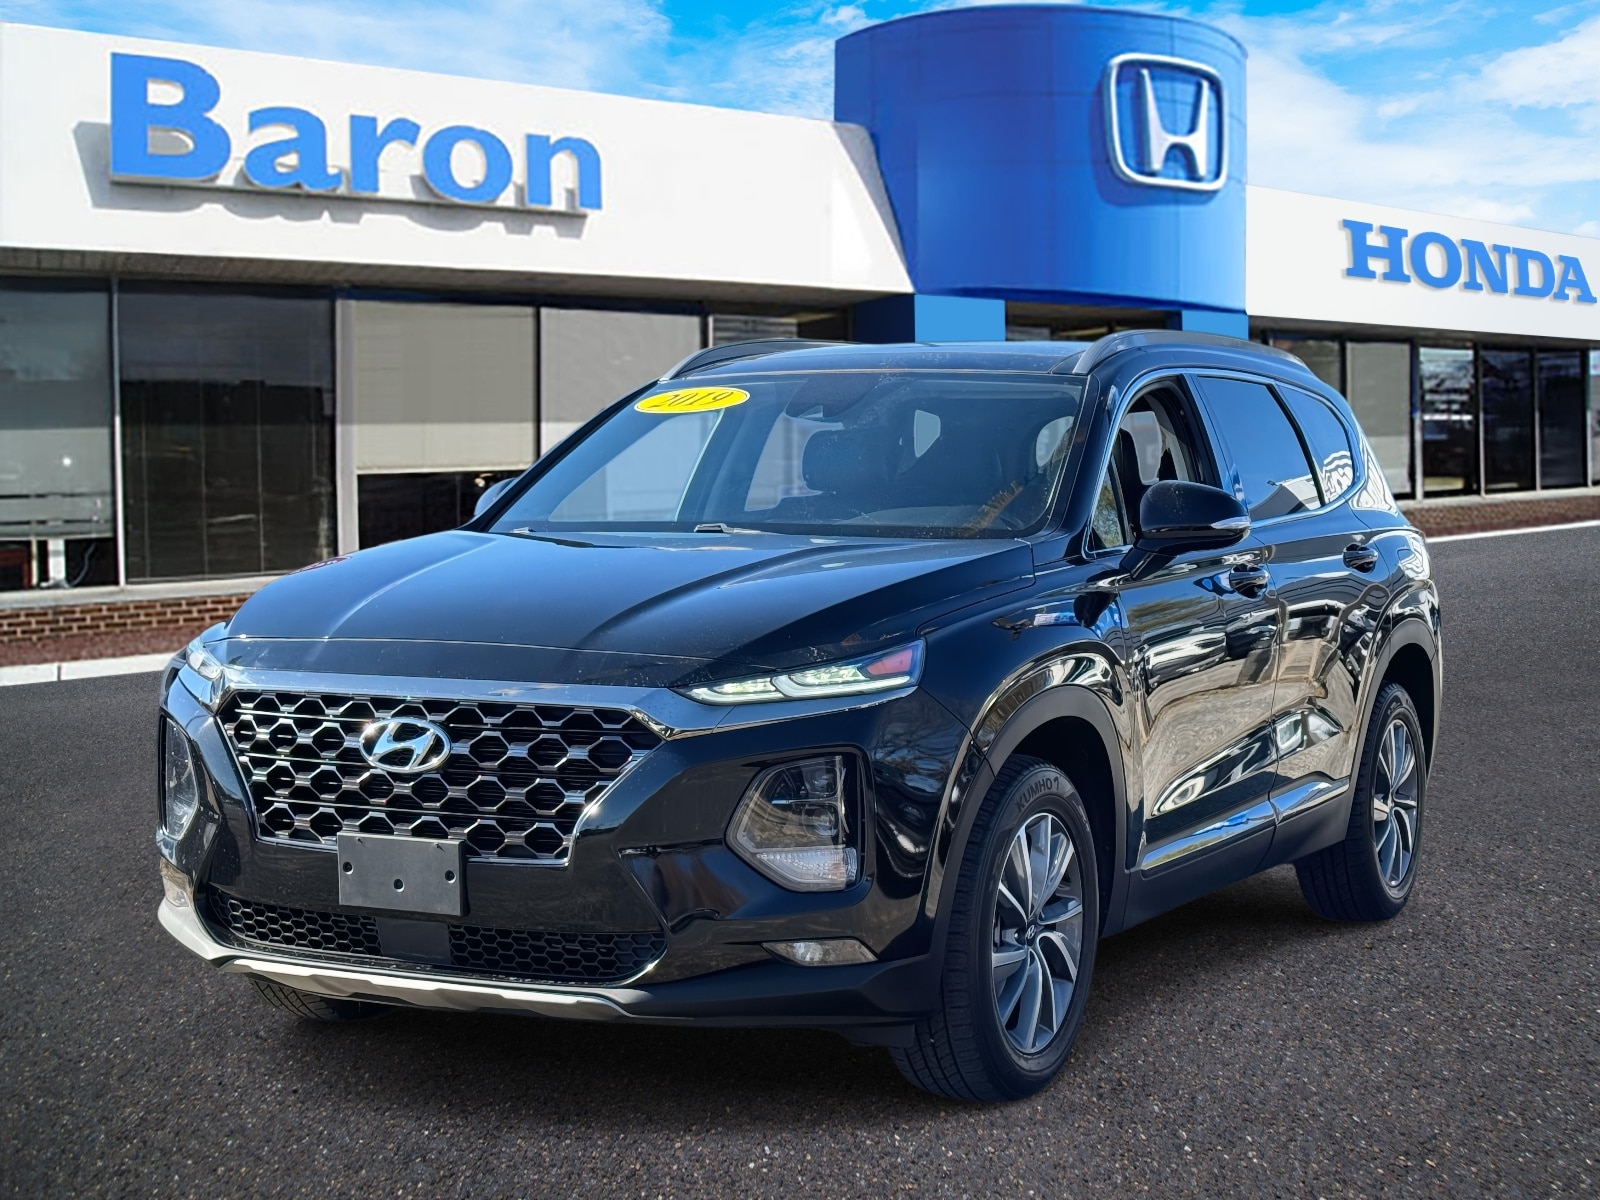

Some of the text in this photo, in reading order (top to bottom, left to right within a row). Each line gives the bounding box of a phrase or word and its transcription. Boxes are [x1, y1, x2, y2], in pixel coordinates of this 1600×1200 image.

[110, 51, 602, 211] Baron
[1342, 219, 1598, 304] HONDA
[649, 390, 734, 409] 2019
